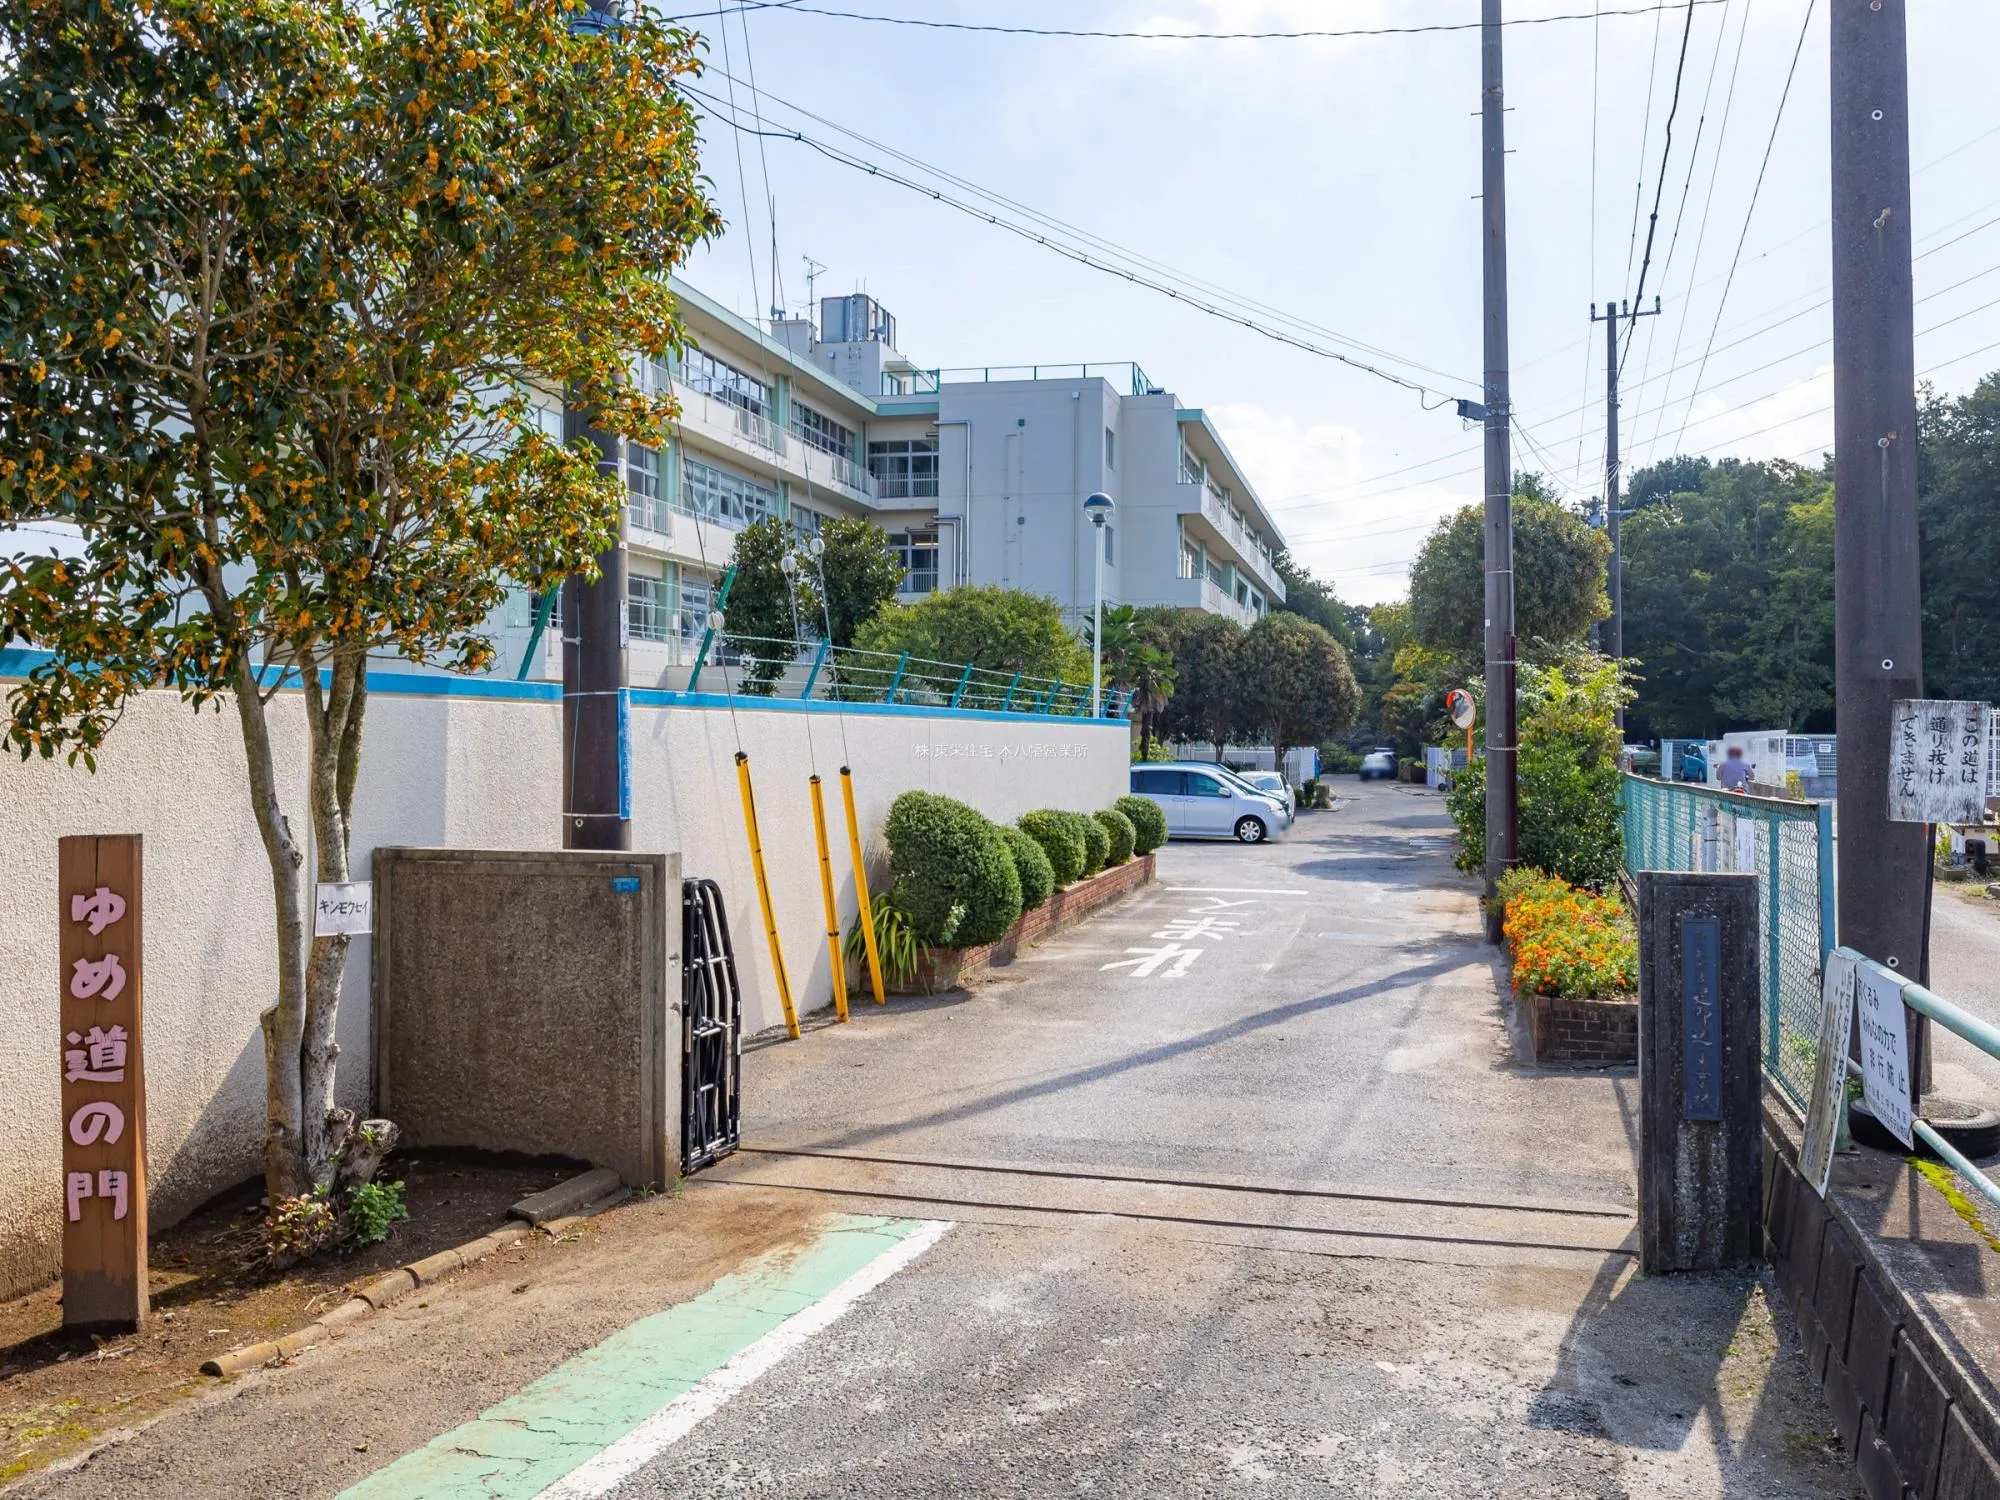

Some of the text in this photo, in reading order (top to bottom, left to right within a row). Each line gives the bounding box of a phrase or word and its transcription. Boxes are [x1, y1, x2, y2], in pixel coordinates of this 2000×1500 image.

[1897, 714, 1919, 798] できません
[1927, 716, 1949, 785] 通り抜け
[1961, 717, 1979, 784] この道は
[319, 899, 368, 916] キンモクセイ
[1098, 896, 1259, 978] とまれ
[64, 886, 129, 1222] ゆめ道の門
